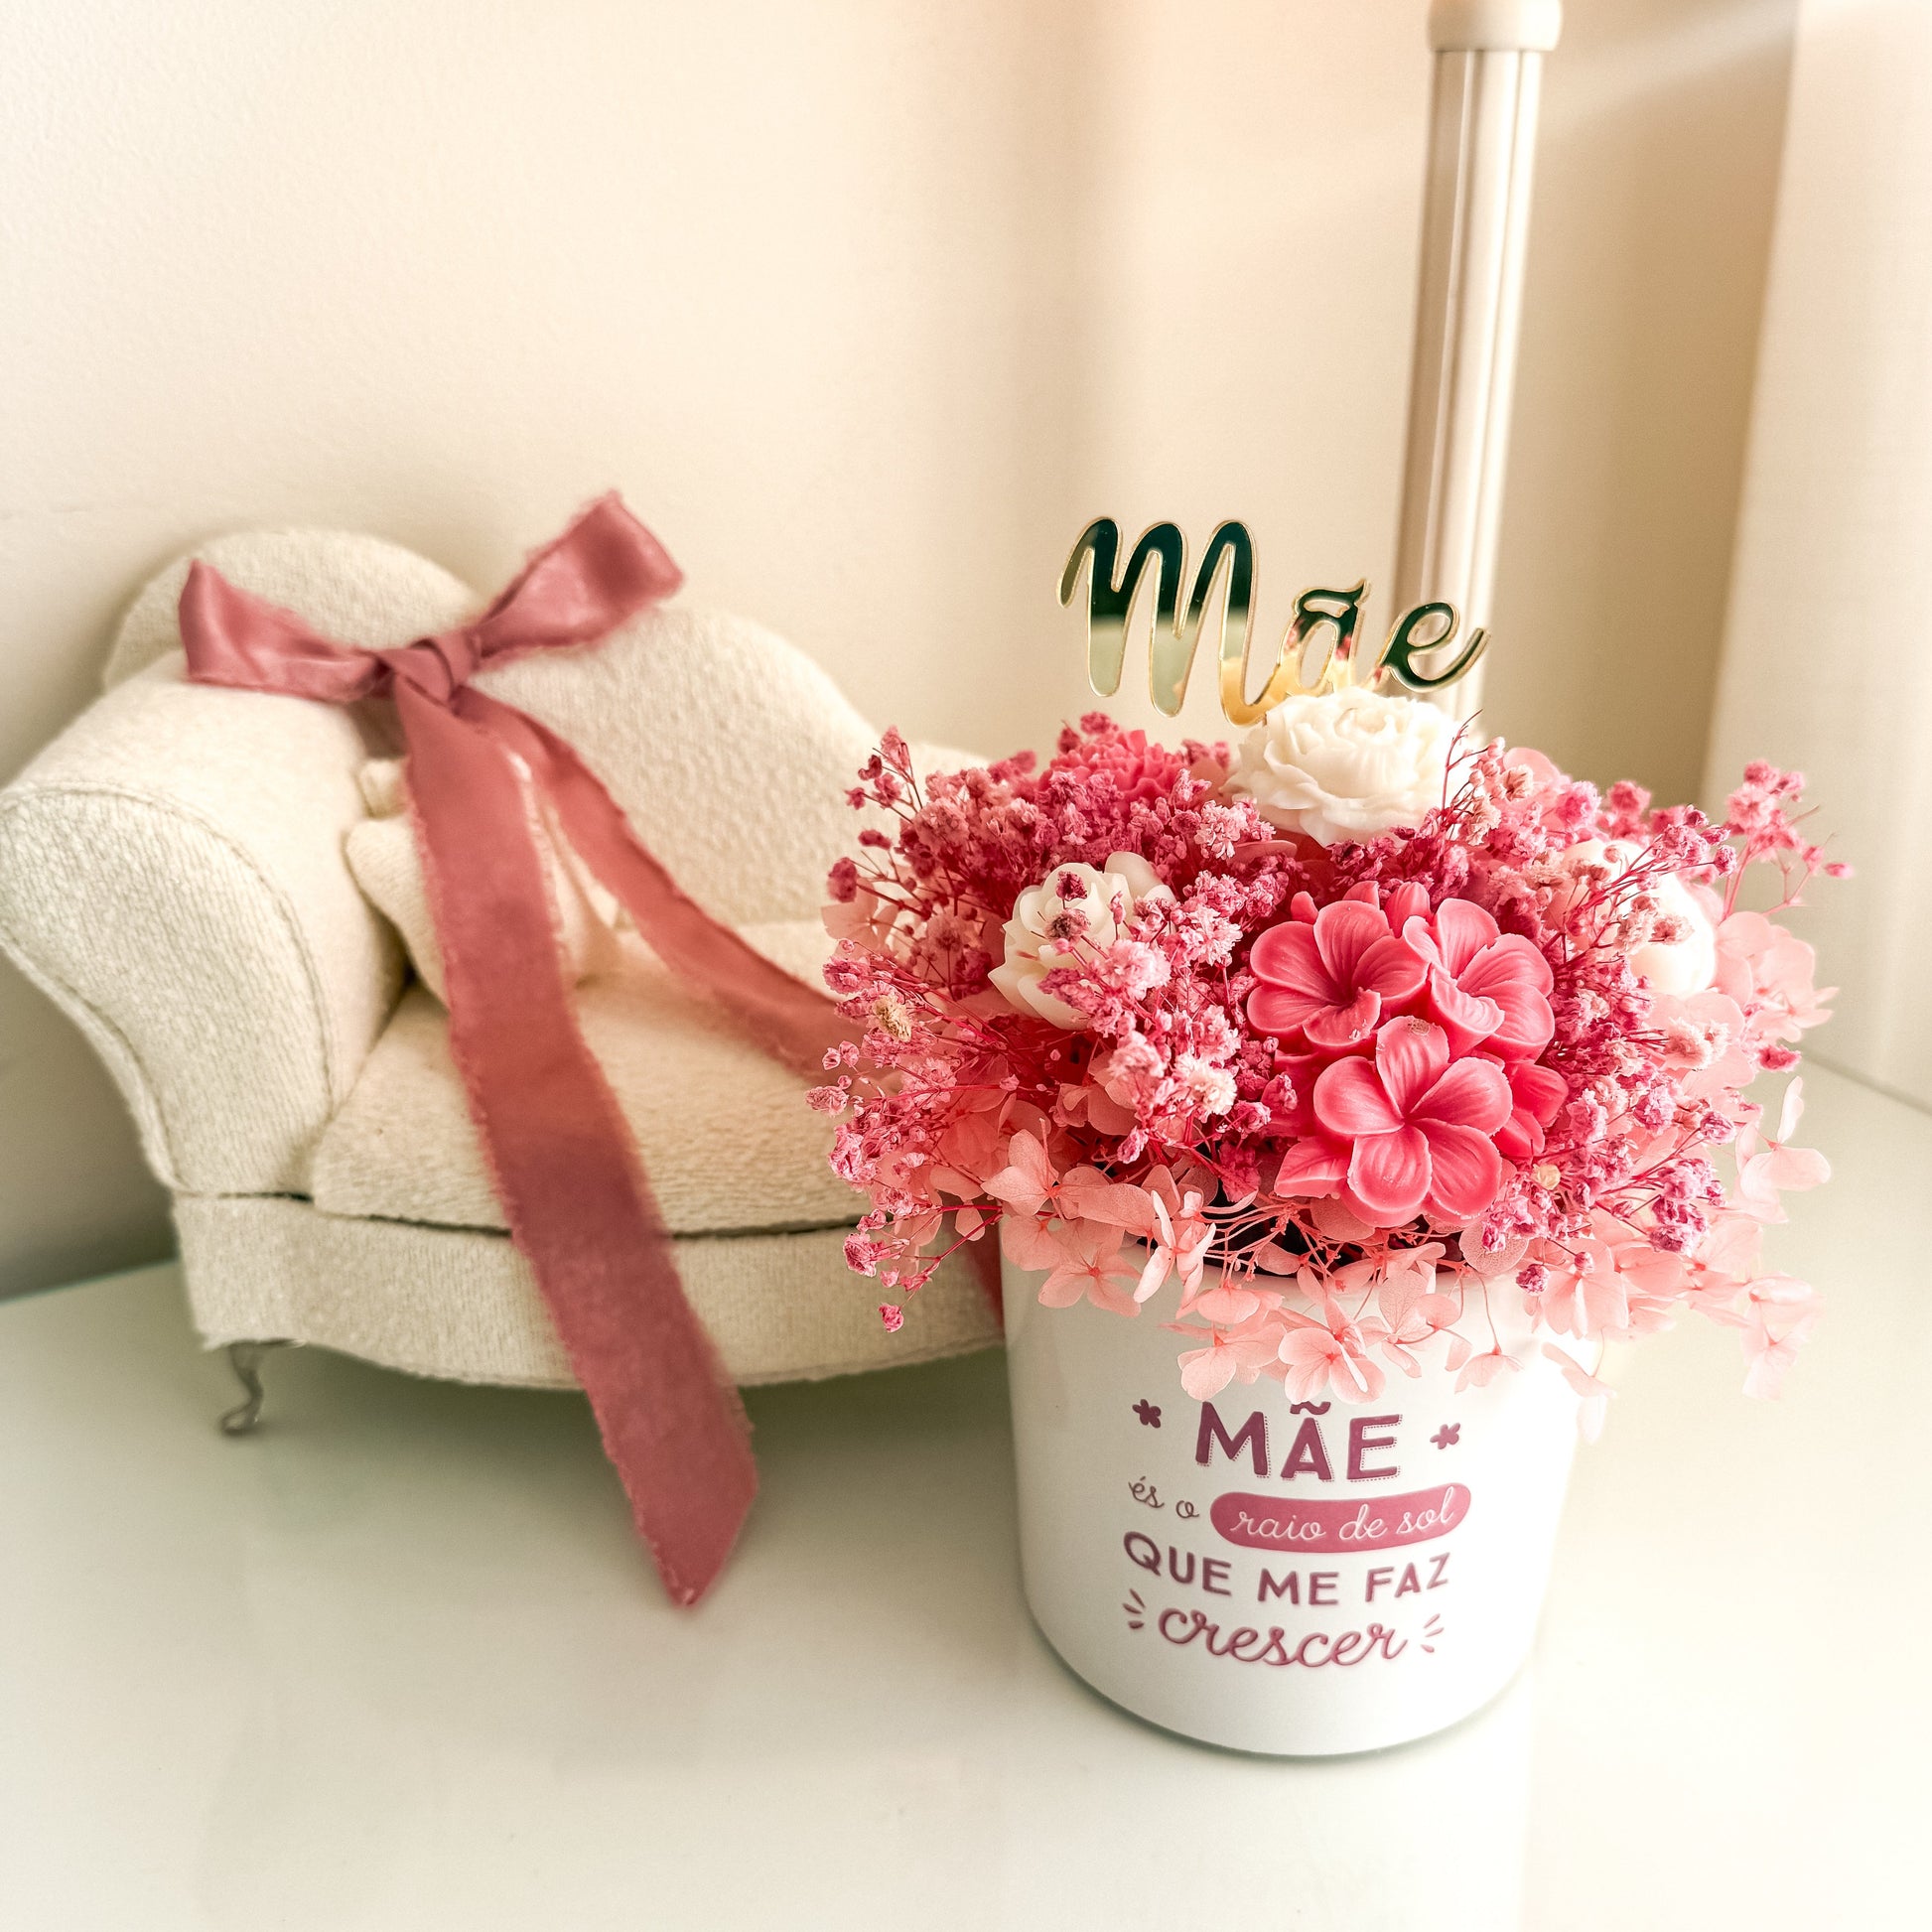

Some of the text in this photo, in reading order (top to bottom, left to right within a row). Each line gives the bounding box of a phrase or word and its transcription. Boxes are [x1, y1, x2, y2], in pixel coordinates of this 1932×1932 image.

[1056, 516, 1491, 727] Mãe
[1195, 1401, 1404, 1482] MÃE
[1129, 1475, 1456, 1541] és o raio de sol
[1123, 1531, 1451, 1606] QUE ME FAZ
[1158, 1605, 1408, 1668] crescer
